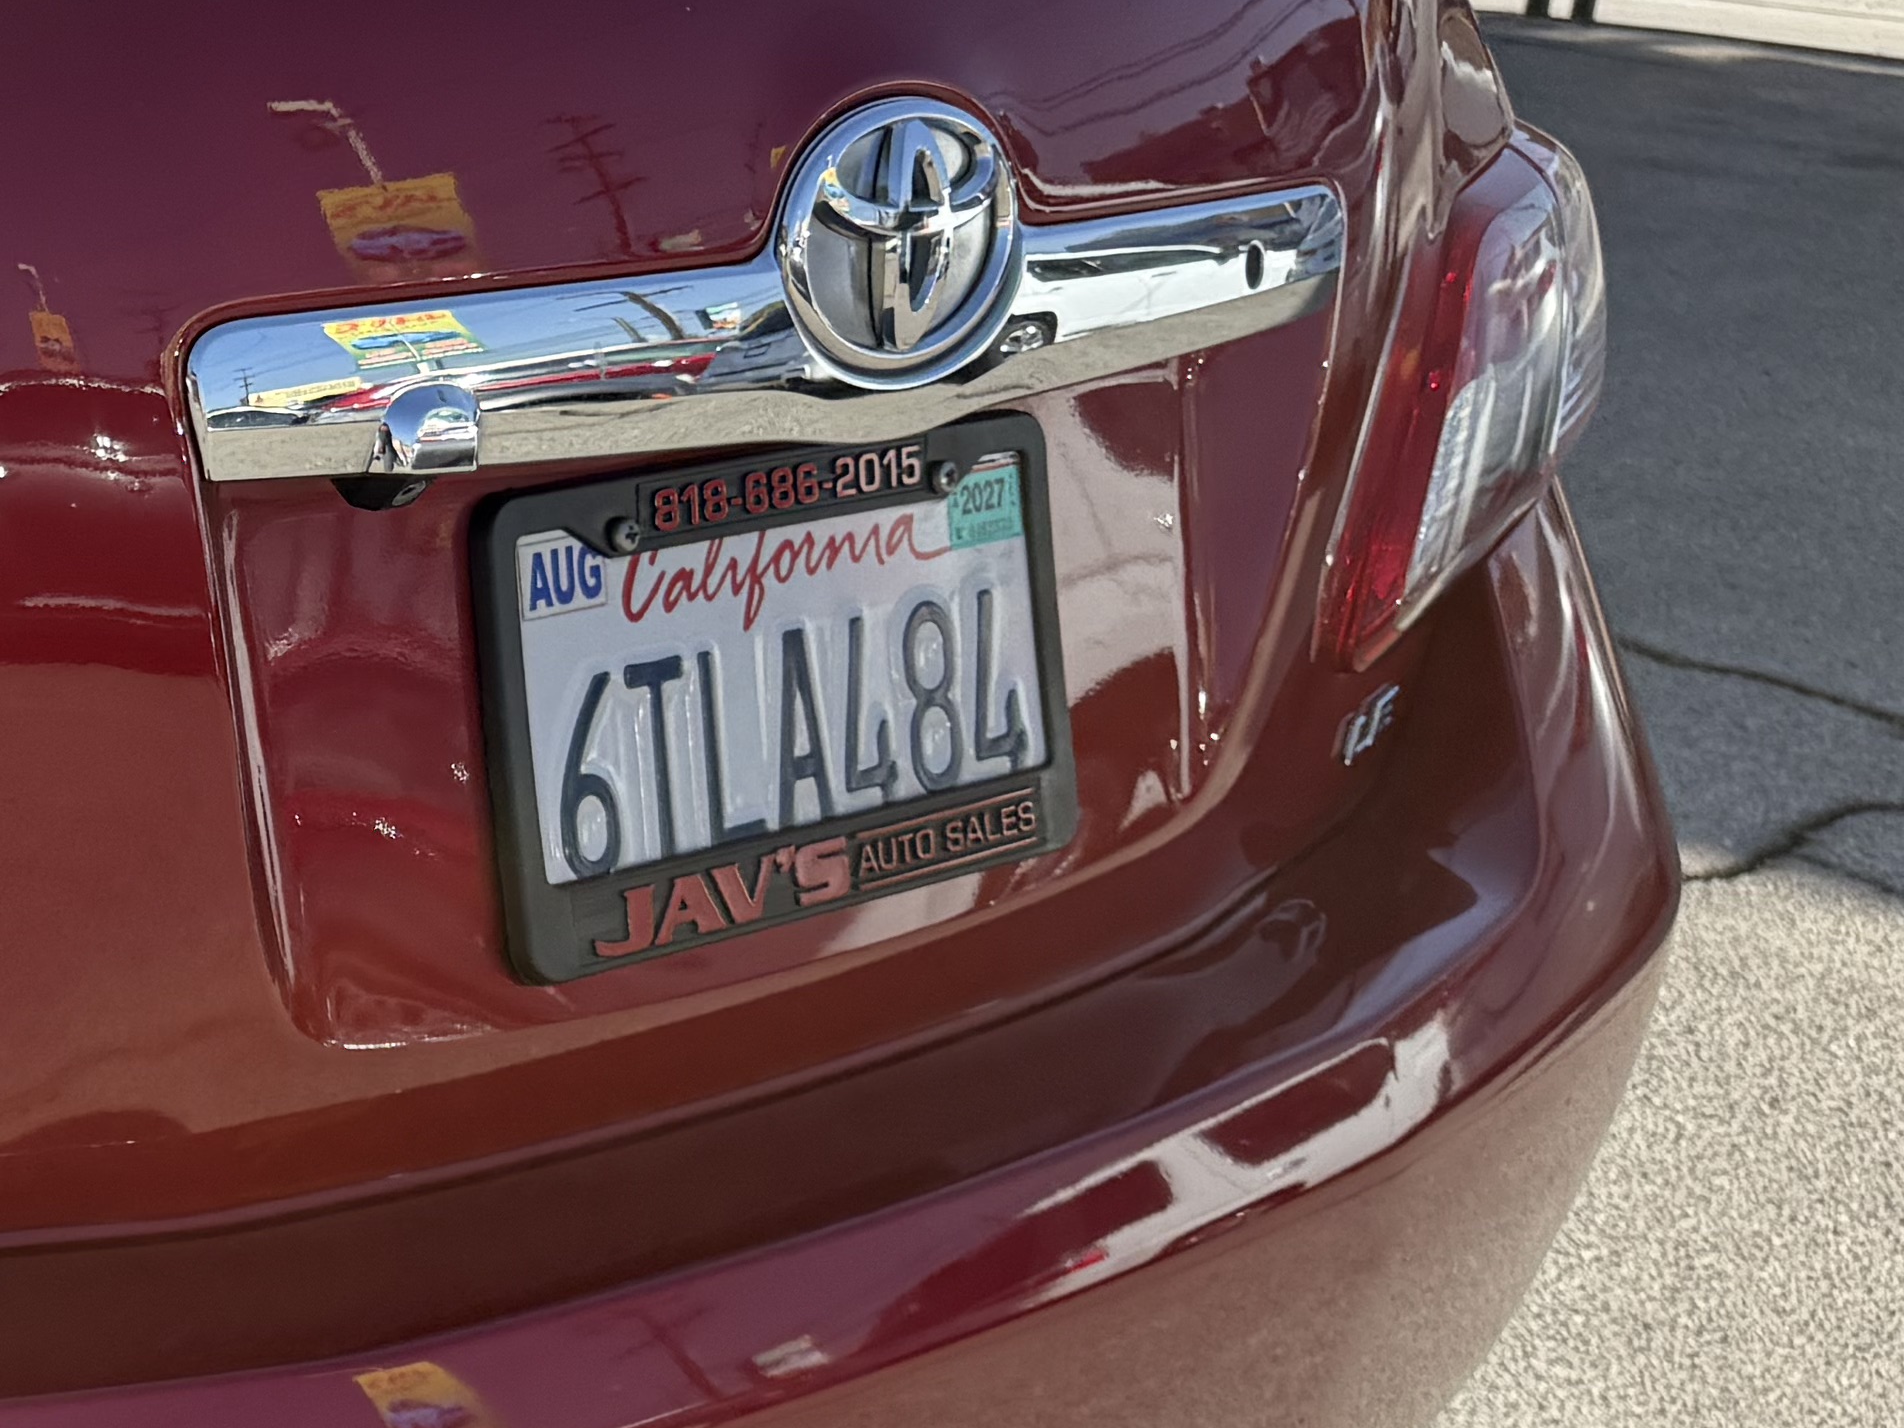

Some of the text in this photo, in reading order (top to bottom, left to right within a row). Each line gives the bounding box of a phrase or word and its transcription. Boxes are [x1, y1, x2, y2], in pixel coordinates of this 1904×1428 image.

[653, 444, 923, 532] 818-686-2015
[960, 477, 1005, 516] 2027
[529, 544, 603, 612] AUG
[621, 512, 955, 632] California
[558, 588, 1029, 880] 6TLA484
[591, 801, 1038, 959] JAV'S AUTO SALES
